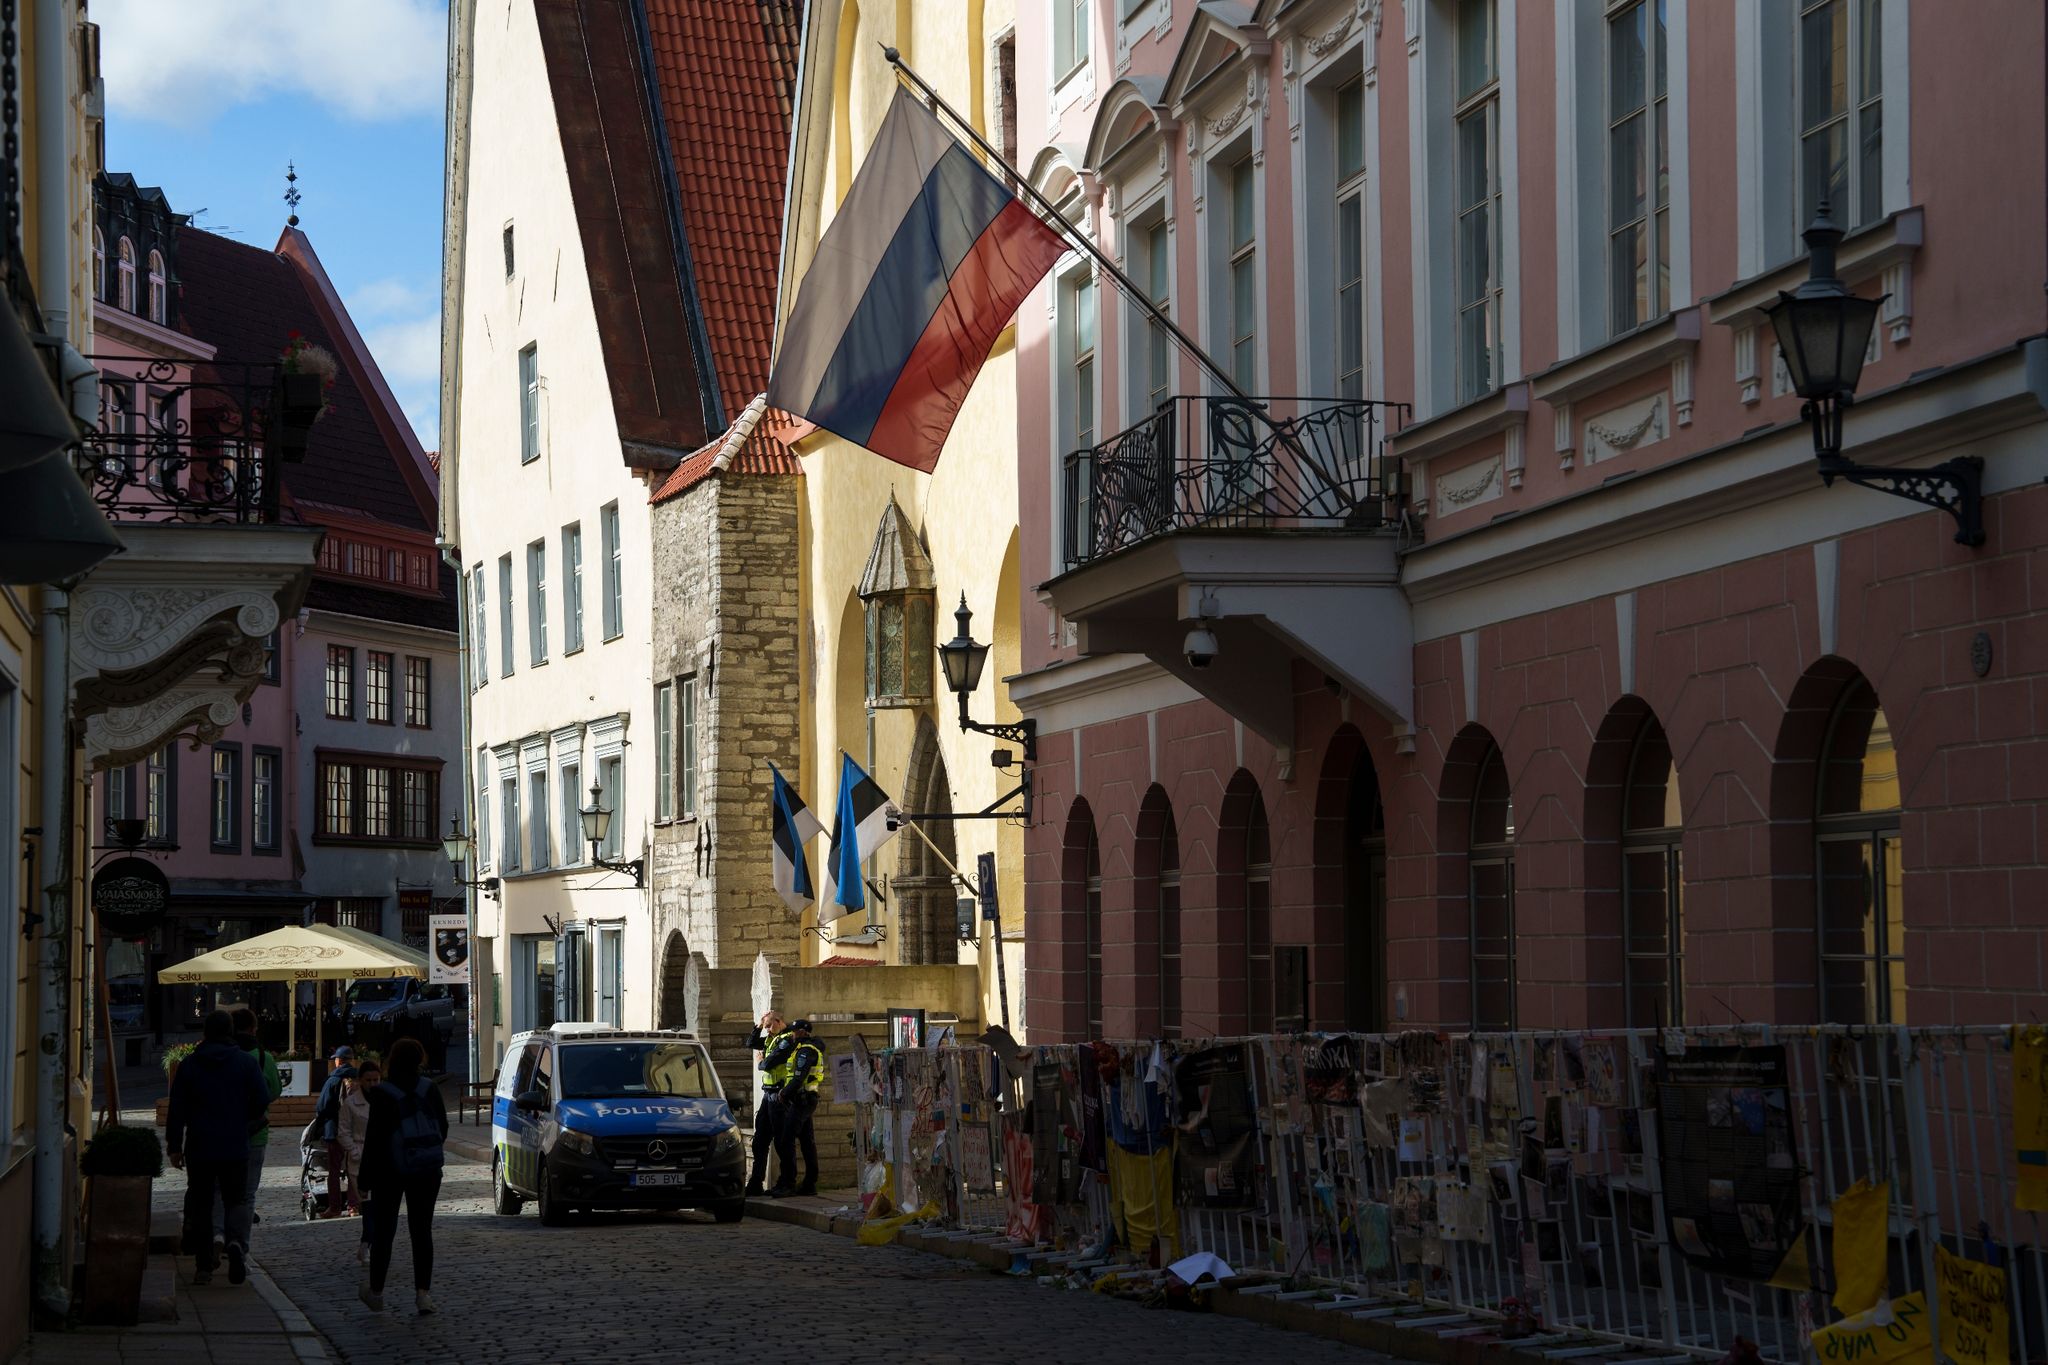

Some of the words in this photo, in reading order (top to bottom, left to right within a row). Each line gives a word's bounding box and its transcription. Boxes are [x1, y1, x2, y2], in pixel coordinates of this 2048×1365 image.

[95, 889, 165, 901] MAIASMOKK
[177, 971, 202, 983] saku
[235, 970, 260, 981] saku
[294, 968, 319, 980] saku
[352, 967, 377, 978] saku
[597, 1104, 705, 1119] POLITSEI
[638, 1175, 657, 1185] 505
[662, 1174, 683, 1185] BYL
[1886, 1299, 1922, 1342] NO
[1825, 1331, 1878, 1361] WAR
